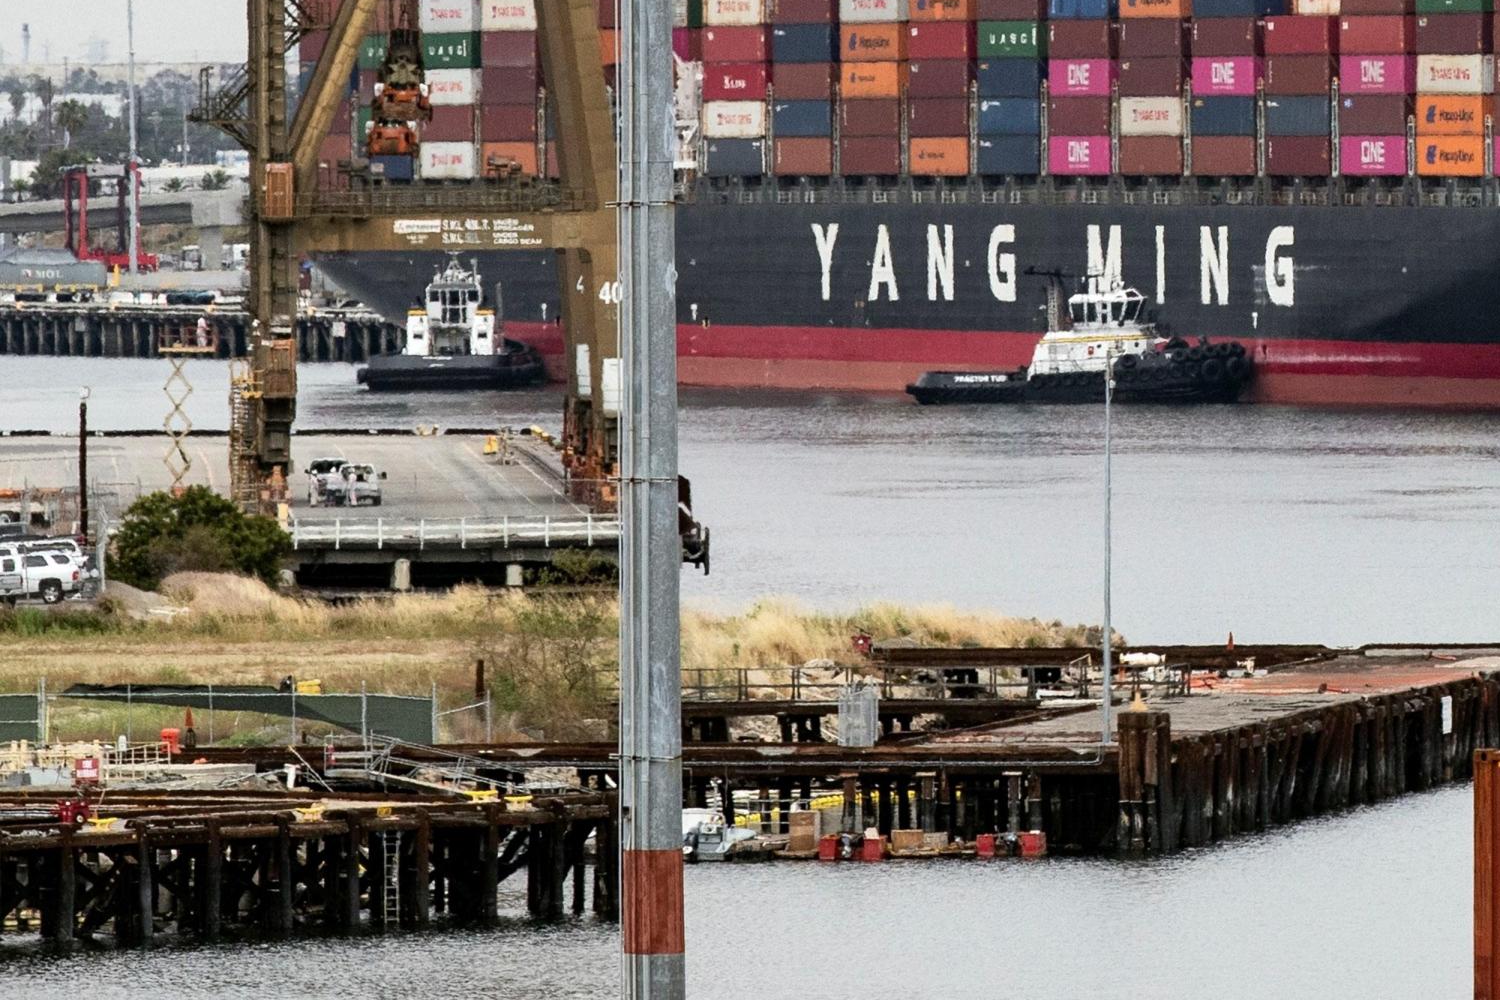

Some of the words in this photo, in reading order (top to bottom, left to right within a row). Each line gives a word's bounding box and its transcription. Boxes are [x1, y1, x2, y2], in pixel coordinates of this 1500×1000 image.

[1068, 64, 1090, 85] ONE
[1211, 62, 1235, 83] ONE
[1361, 60, 1385, 82] ONE
[1068, 142, 1089, 162] ONE
[1361, 141, 1385, 163] ONE
[36, 269, 63, 279] MOL
[811, 223, 1017, 302] YANG
[1087, 224, 1294, 307] MING
